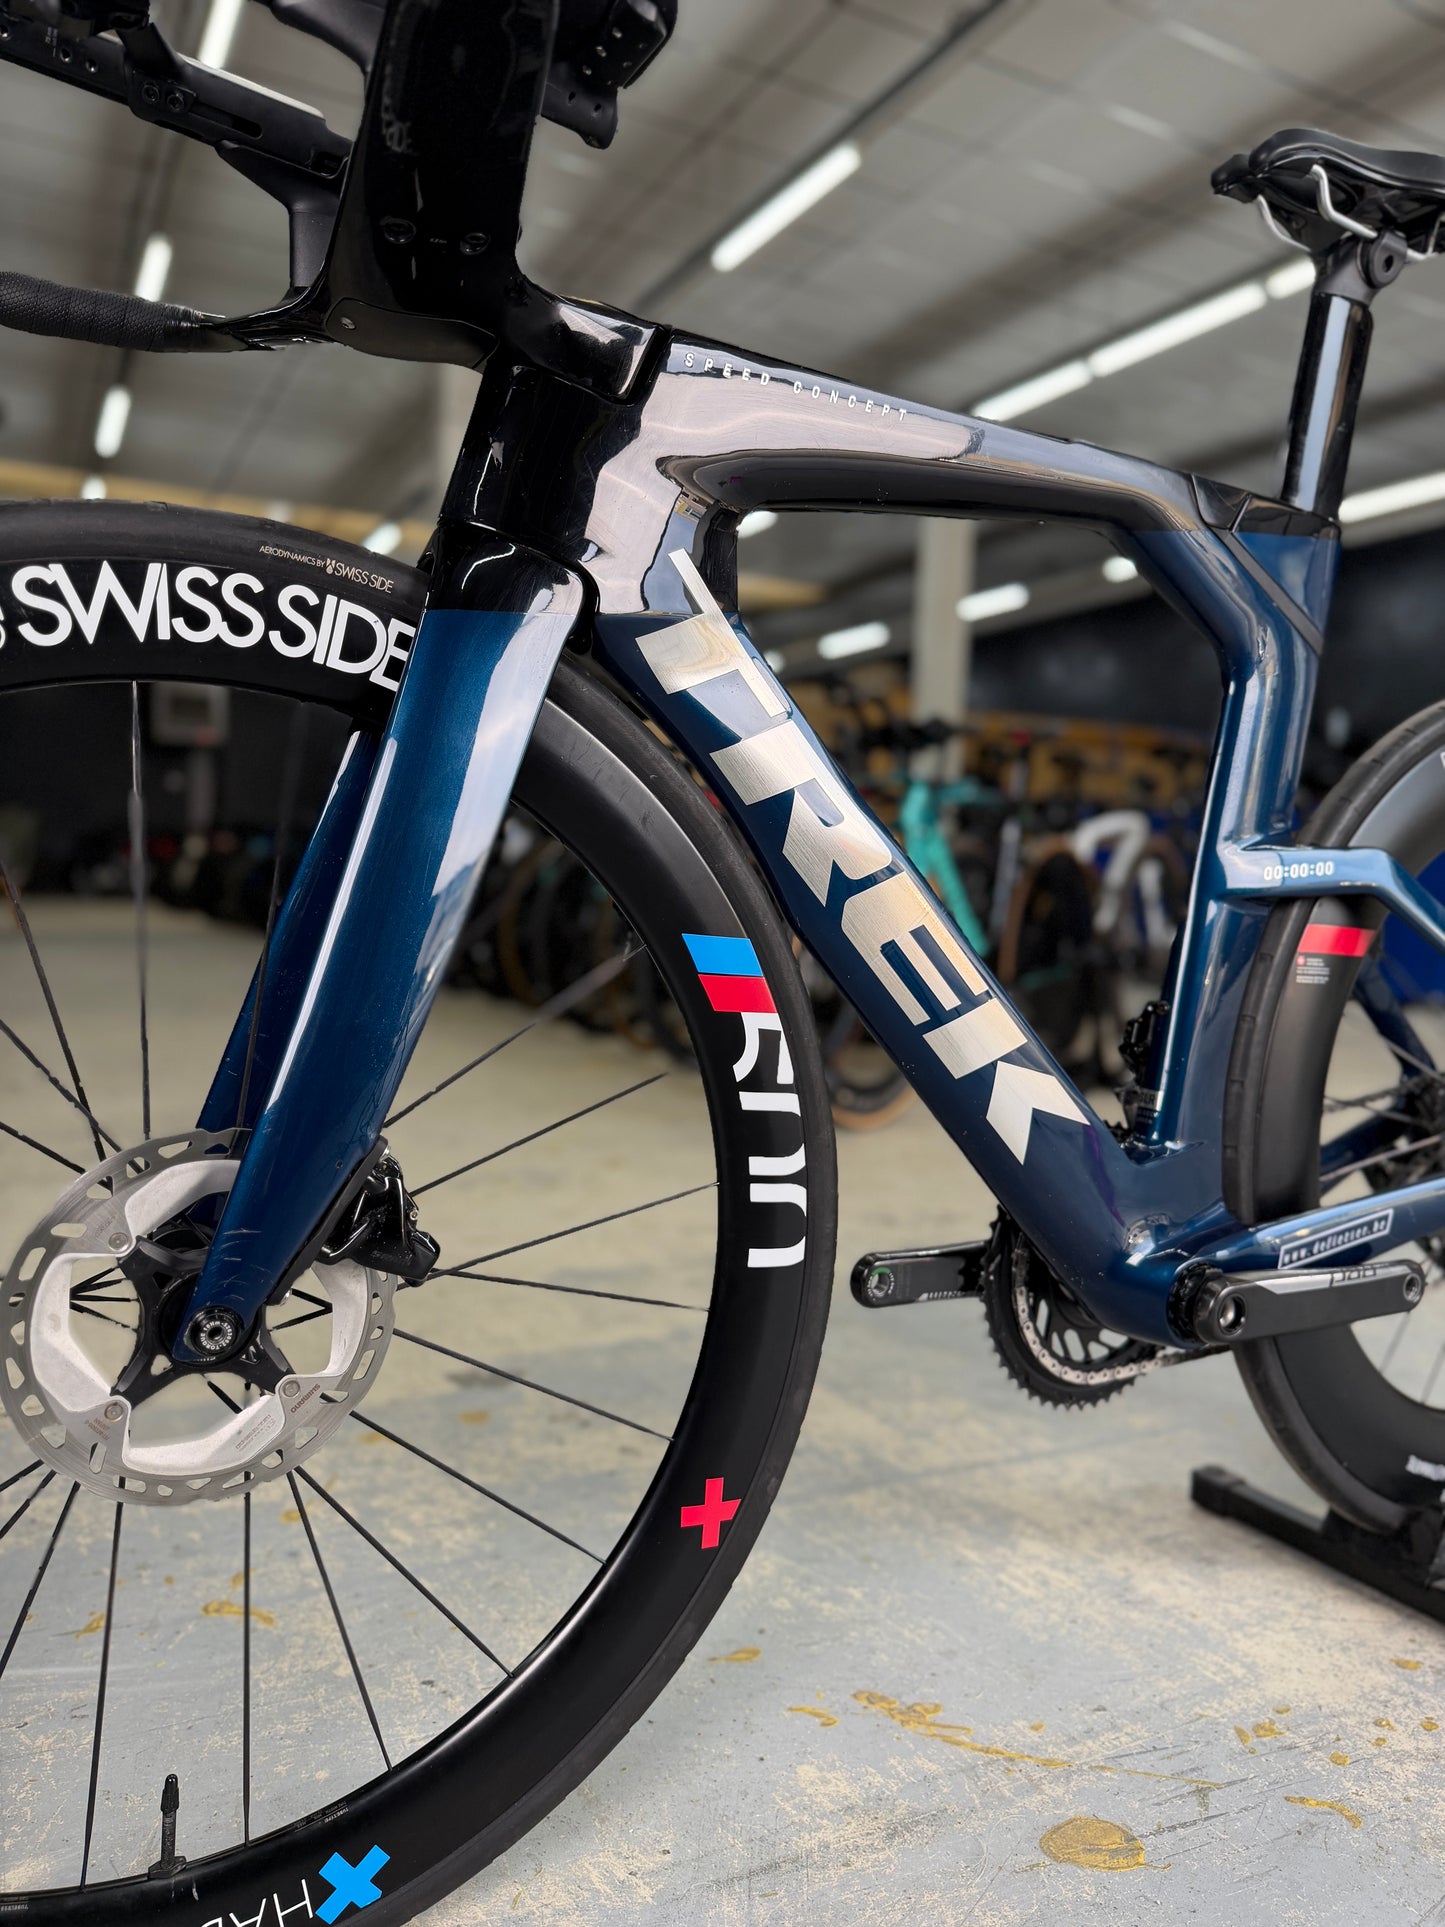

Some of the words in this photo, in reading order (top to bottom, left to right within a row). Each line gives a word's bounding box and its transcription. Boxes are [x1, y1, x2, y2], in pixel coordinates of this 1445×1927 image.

[684, 352, 770, 386] SPEED
[793, 381, 907, 422] CONCEPT
[259, 545, 316, 566] AERODYNAMICS
[316, 559, 325, 568] BY
[335, 562, 369, 585] SWISS
[368, 574, 394, 594] SIDE
[11, 560, 265, 648] SWISS
[268, 584, 419, 693] SIDE
[635, 549, 1090, 1165] TREK
[1263, 861, 1335, 881] 00:00:00
[290, 1383, 321, 1414] SHIMANO
[201, 1878, 314, 1927] HA
